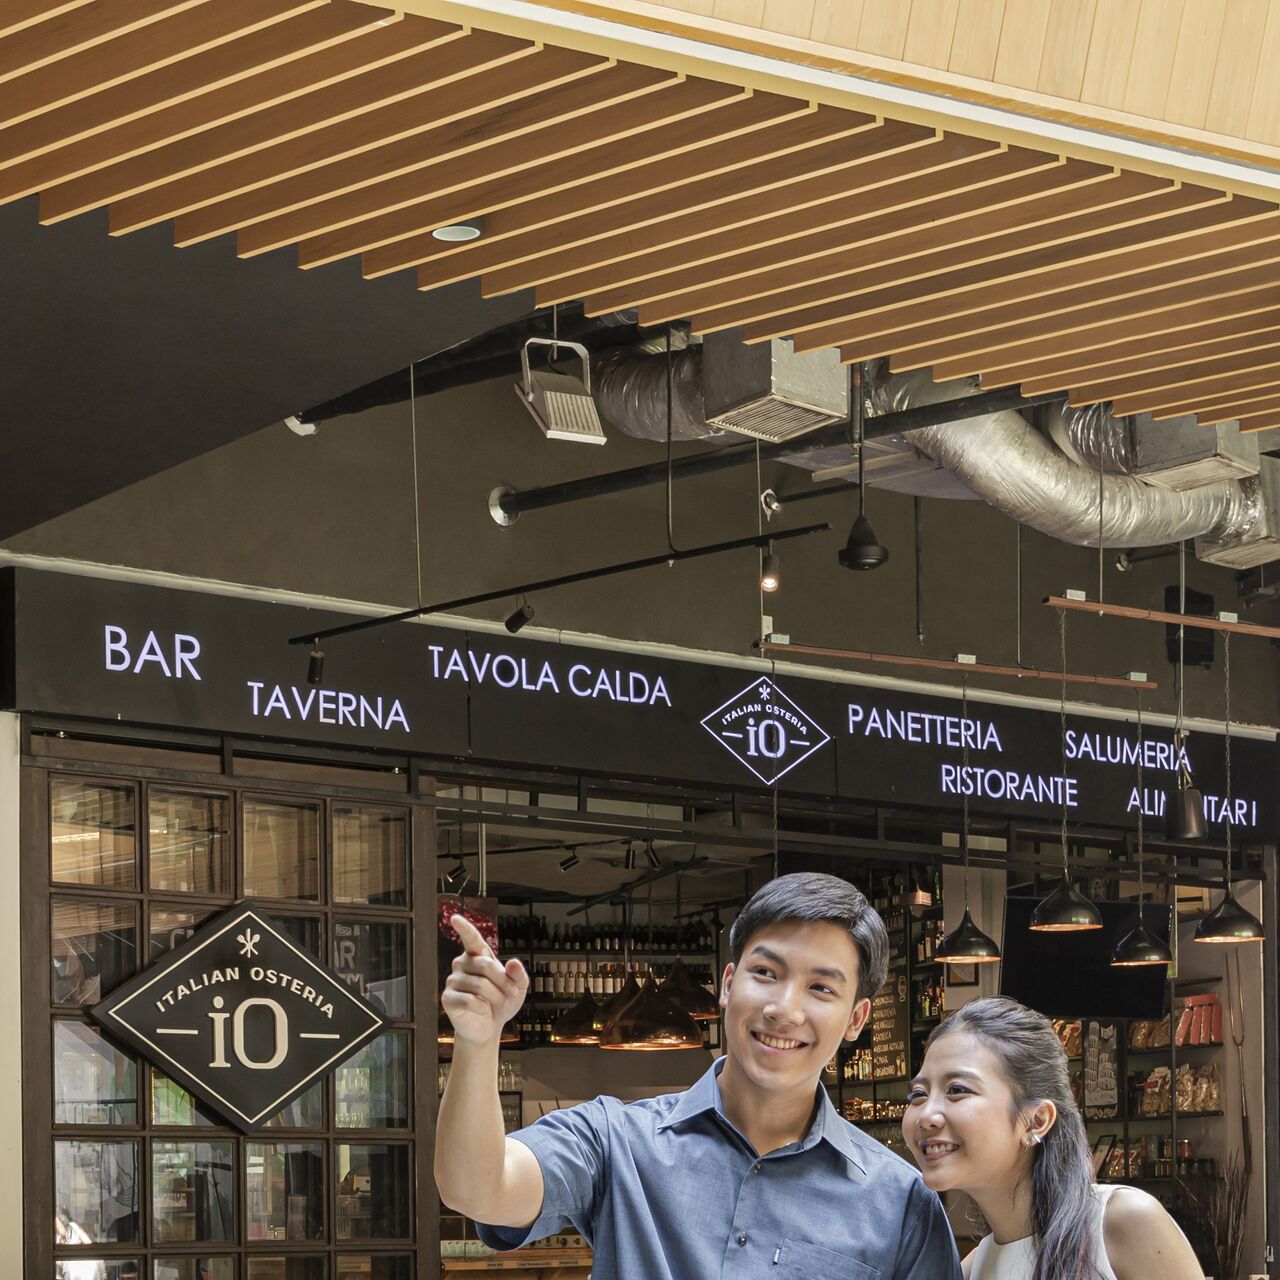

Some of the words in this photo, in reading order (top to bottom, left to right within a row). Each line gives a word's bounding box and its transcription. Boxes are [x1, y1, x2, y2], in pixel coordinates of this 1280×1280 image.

[105, 625, 201, 680] BAR
[428, 645, 559, 694] TAVOLA
[568, 663, 671, 707] CALDA
[247, 681, 410, 732] TAVERNA
[722, 704, 761, 725] ITALIAN
[765, 704, 807, 735] OSTERIA
[847, 703, 1002, 752] PANETTERIA
[1065, 730, 1192, 772] SALUMERIA
[941, 764, 1078, 806] RISTORANTE
[1126, 787, 1256, 826] ALITARI
[155, 967, 239, 1013] ITALIAN
[250, 967, 335, 1019] OSTERIA
